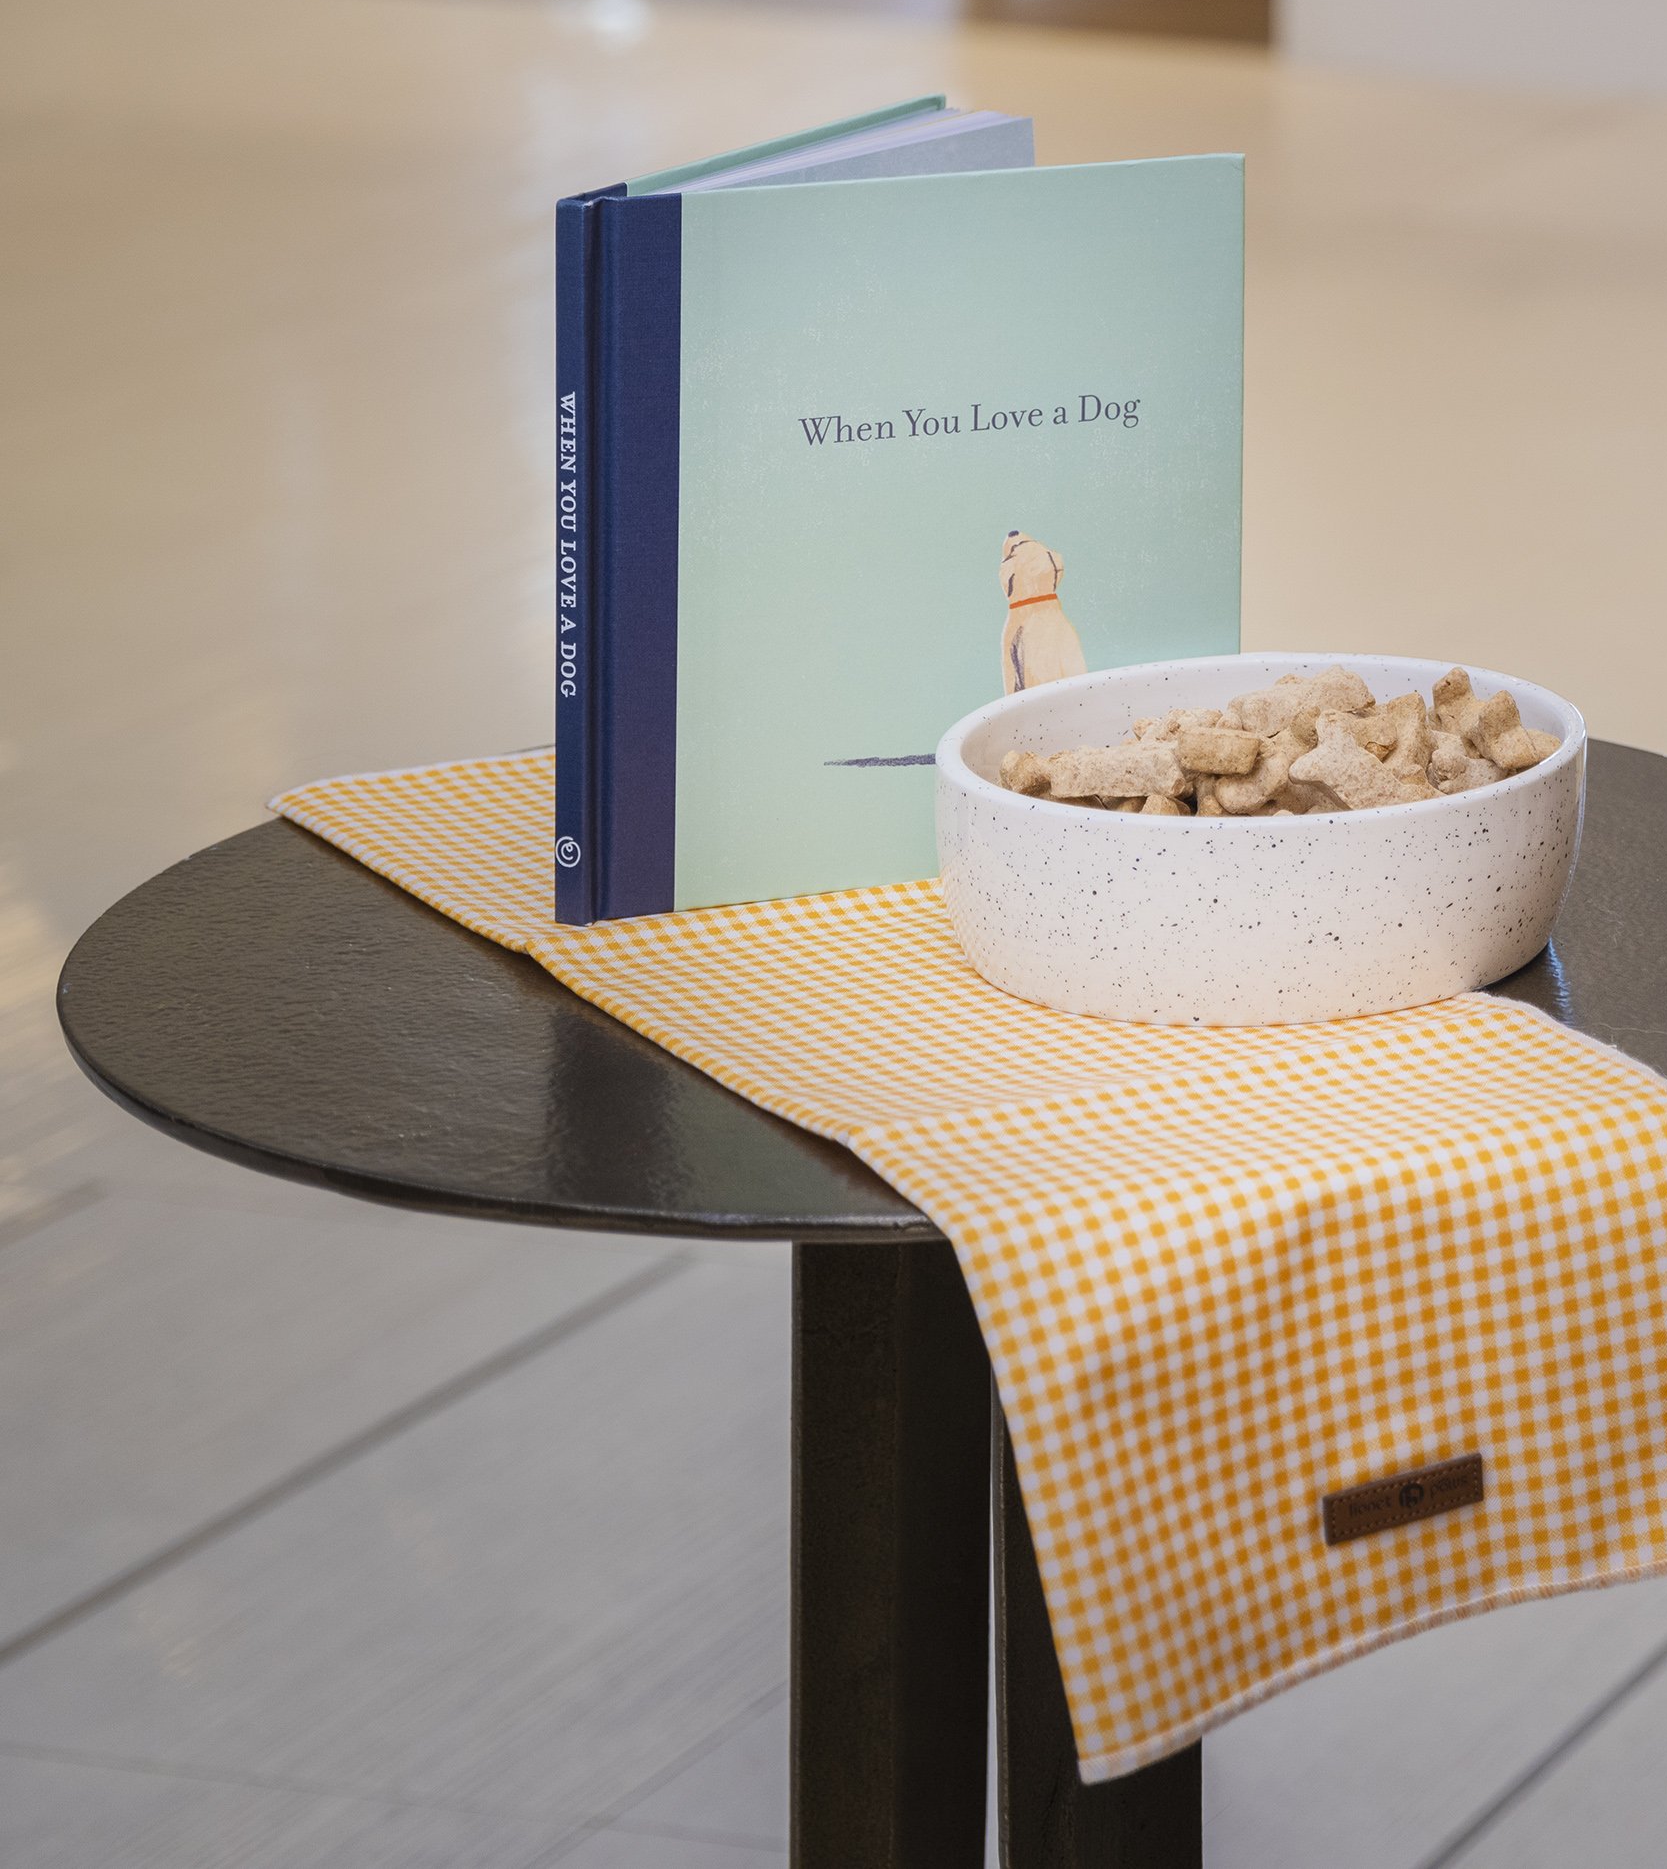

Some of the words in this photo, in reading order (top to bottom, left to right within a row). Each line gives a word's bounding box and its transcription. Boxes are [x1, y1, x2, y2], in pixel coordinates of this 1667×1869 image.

[560, 391, 577, 474] WHEN
[797, 414, 896, 446] When
[901, 408, 962, 437] You
[970, 403, 1044, 433] Love
[1052, 406, 1070, 426] a
[1077, 394, 1142, 429] Dog
[560, 480, 577, 533] YOU
[560, 539, 577, 608] LOVE
[560, 613, 577, 634] A
[560, 640, 577, 698] DOG
